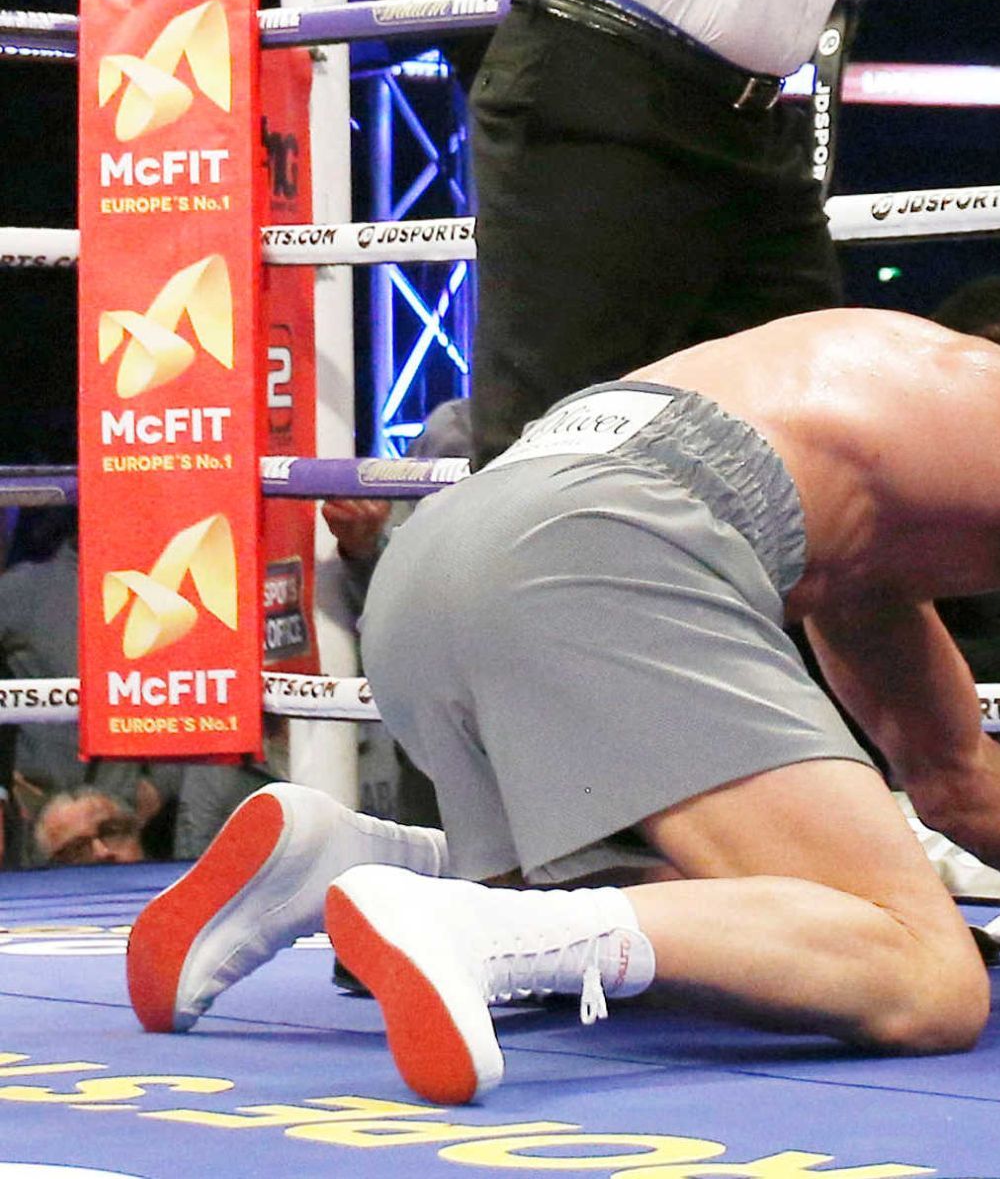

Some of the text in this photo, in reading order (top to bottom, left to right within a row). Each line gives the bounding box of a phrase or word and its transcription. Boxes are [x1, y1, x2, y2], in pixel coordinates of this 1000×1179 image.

[101, 149, 230, 187] McFIT
[101, 407, 231, 445] McFIT
[108, 668, 237, 706] McFIT
